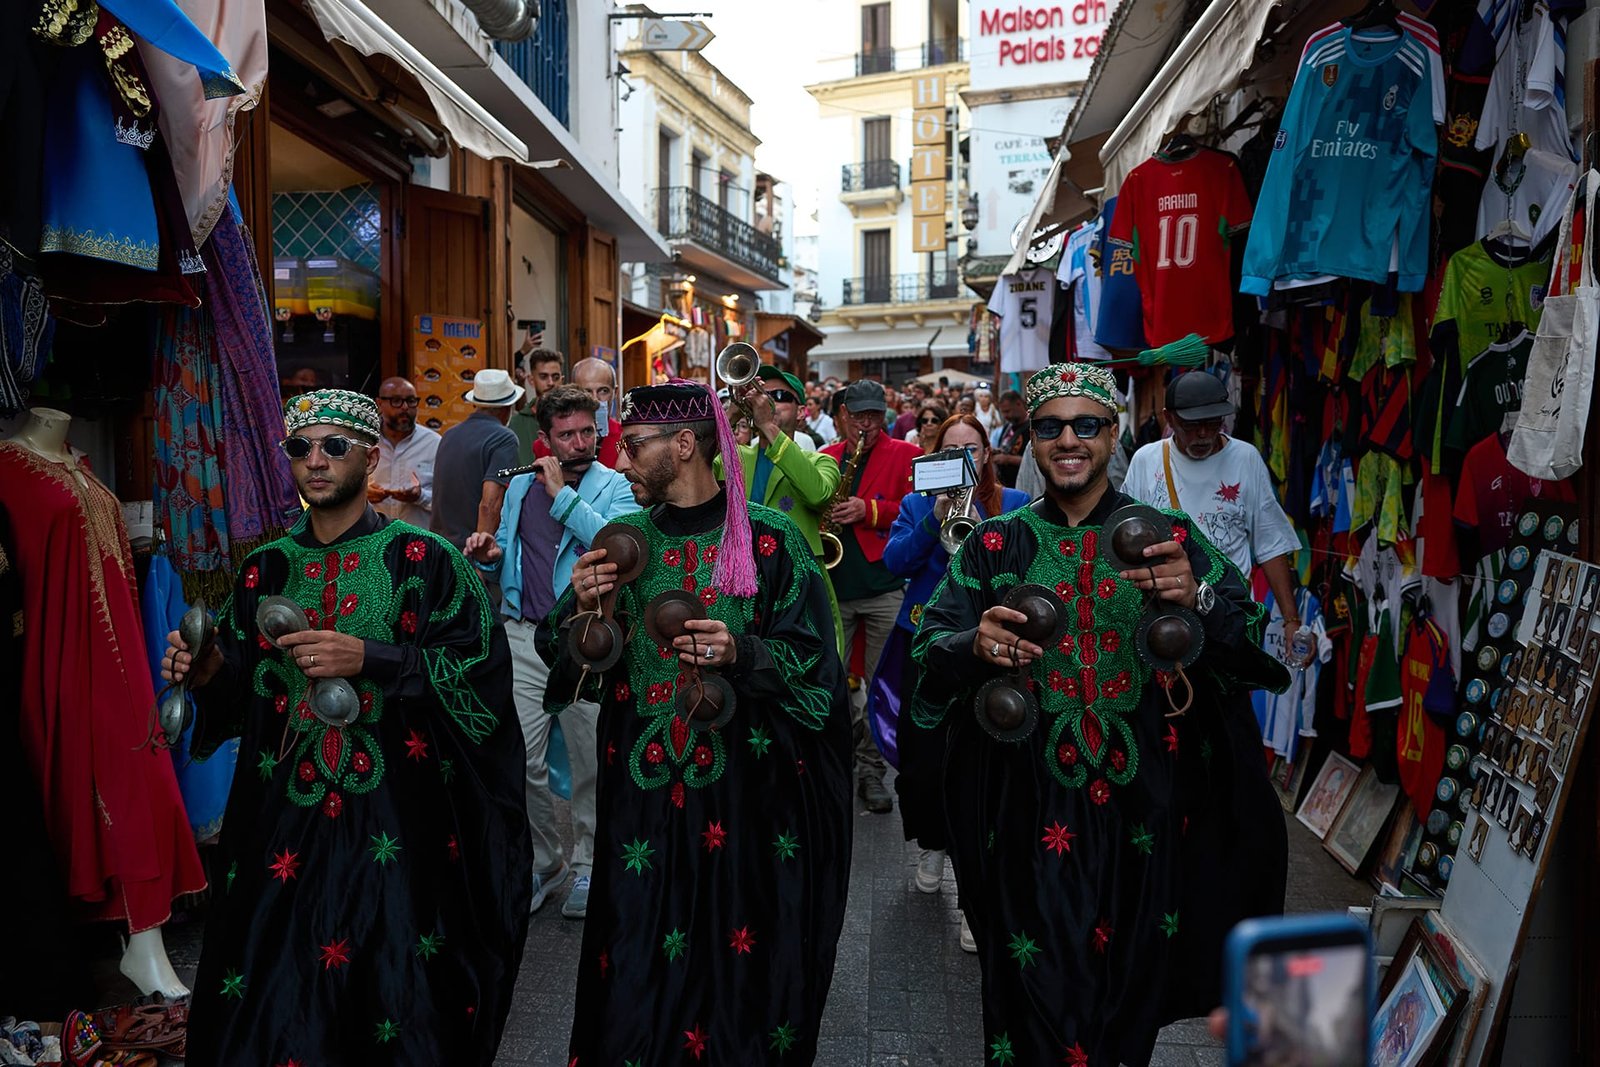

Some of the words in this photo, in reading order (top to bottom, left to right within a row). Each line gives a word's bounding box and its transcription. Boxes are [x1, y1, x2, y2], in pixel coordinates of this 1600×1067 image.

[980, 5, 1063, 36] Maison
[999, 35, 1065, 67] Palais
[1072, 32, 1103, 59] za
[1336, 120, 1360, 138] Fly
[994, 138, 1022, 150] CAFÉ
[1311, 137, 1378, 160] Emirates
[916, 77, 941, 247] HOTEL
[1157, 193, 1198, 212] BRAHIM
[1156, 213, 1199, 271] 10
[1009, 281, 1046, 294] ZIDANE
[1020, 297, 1037, 329] 5
[443, 322, 481, 339] MENU
